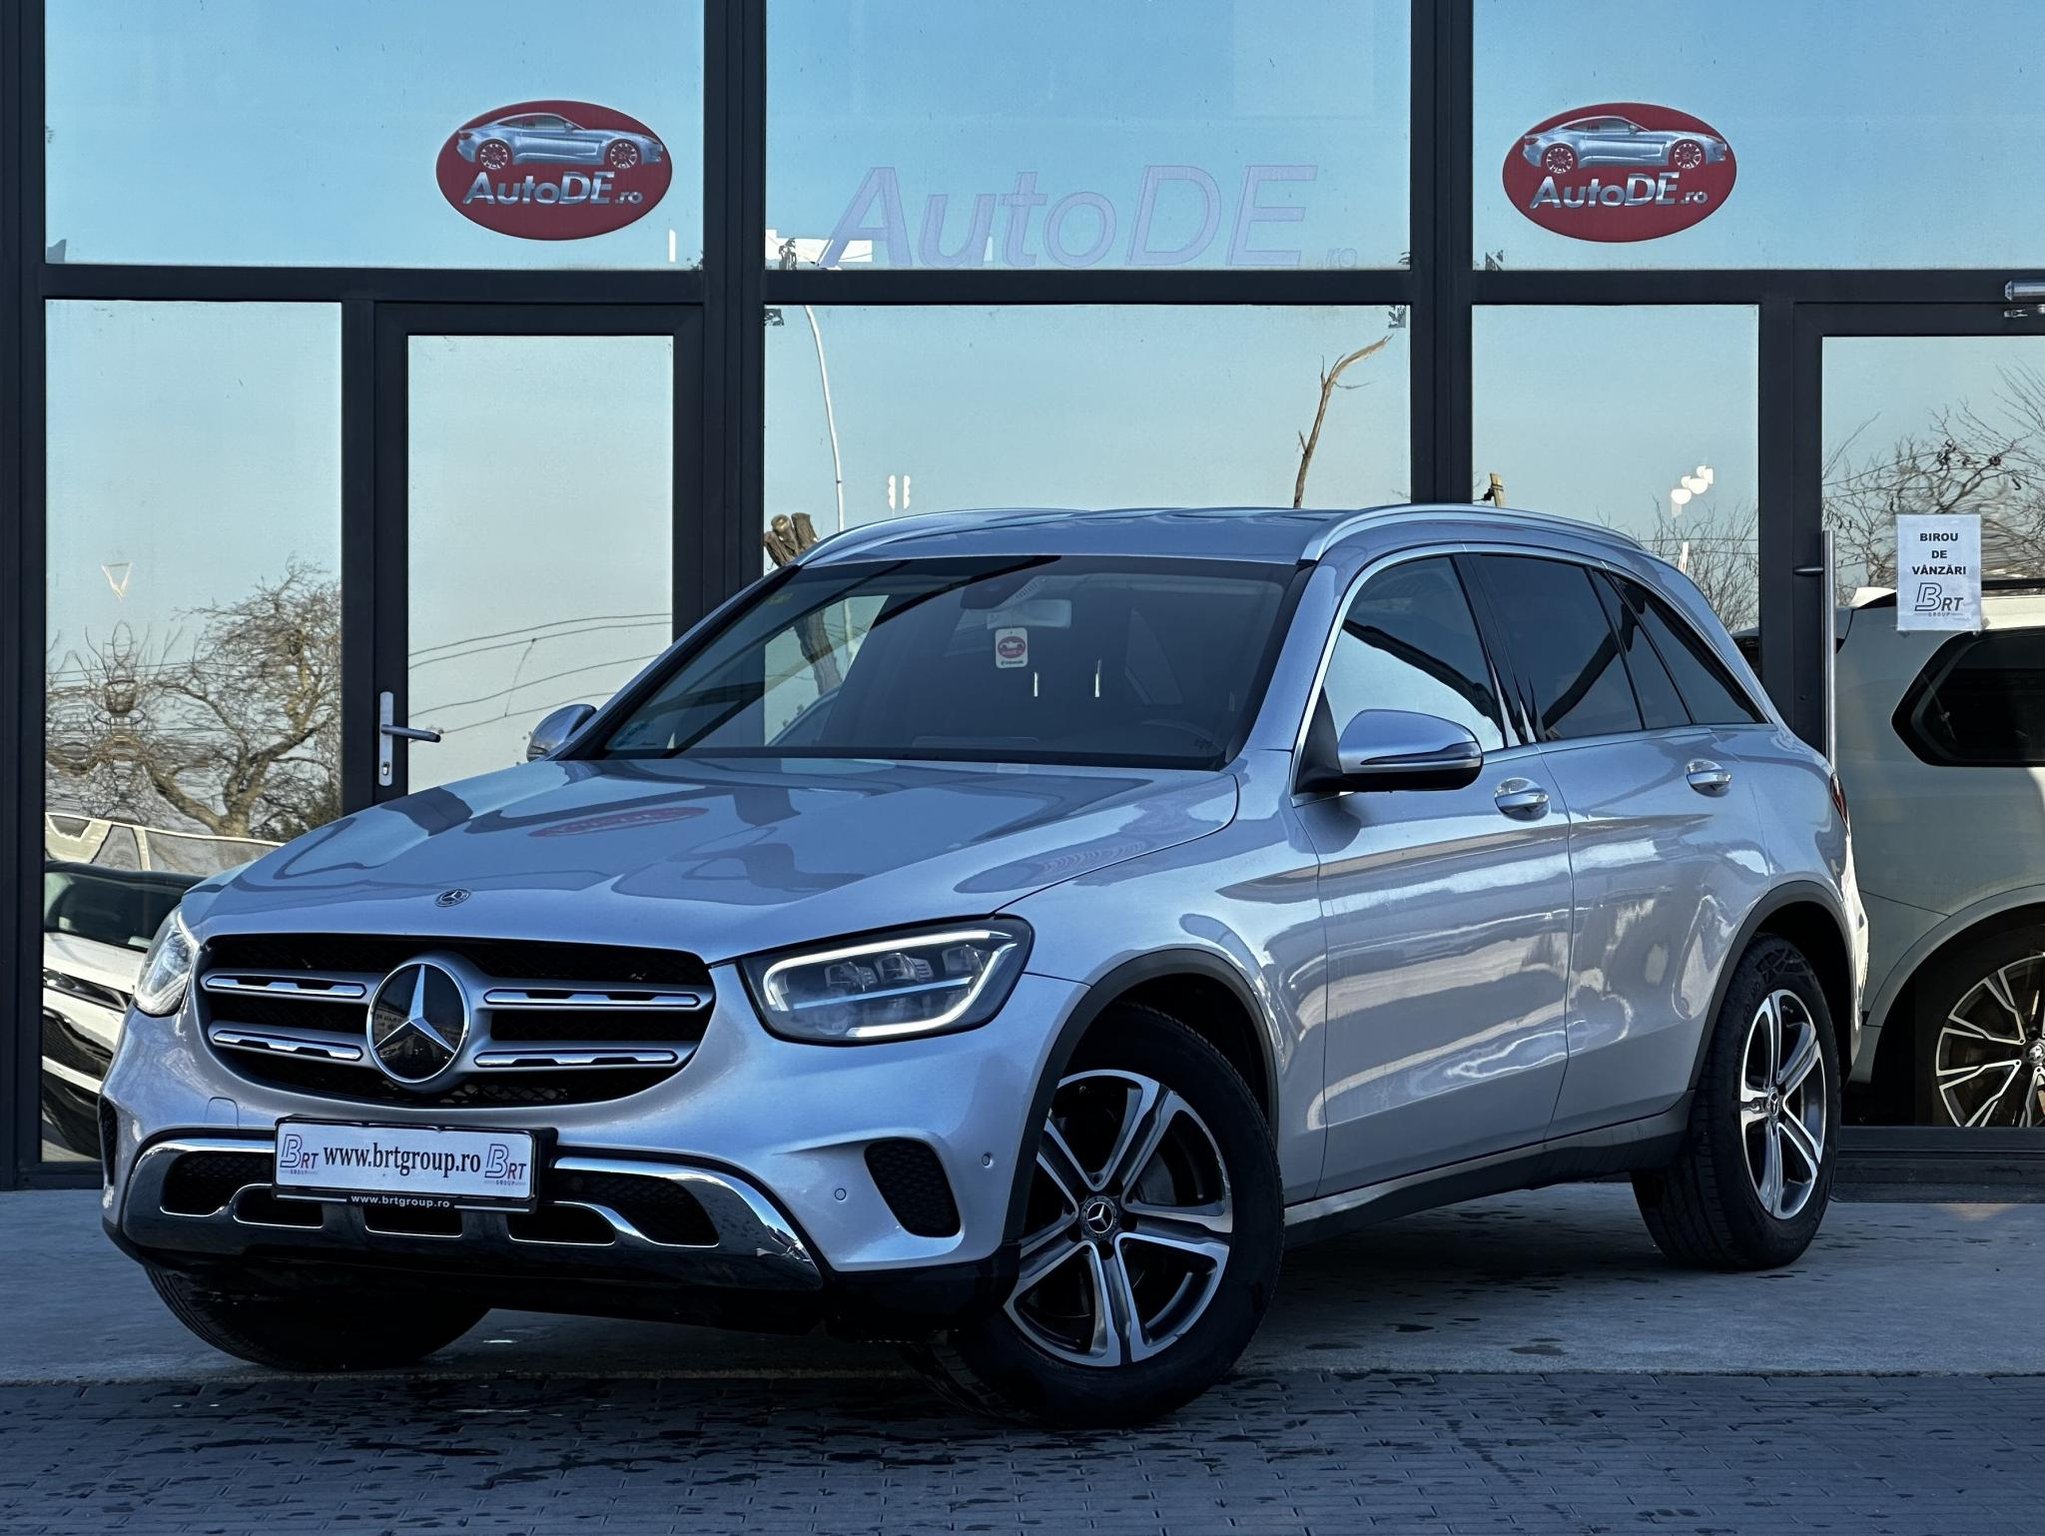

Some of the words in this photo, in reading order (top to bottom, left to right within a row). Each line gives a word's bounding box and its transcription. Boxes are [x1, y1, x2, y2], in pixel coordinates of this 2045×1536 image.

[1919, 532, 1959, 542] BIROU
[1931, 550, 1948, 559] DE
[1911, 564, 1967, 575] VÂNZĂRI
[1914, 582, 1964, 612] BRT
[280, 1133, 319, 1169] BRT
[323, 1142, 481, 1178] www.brtgroup.ro
[485, 1143, 527, 1180] BRT
[350, 1195, 451, 1209] www.brtgroup.ro
